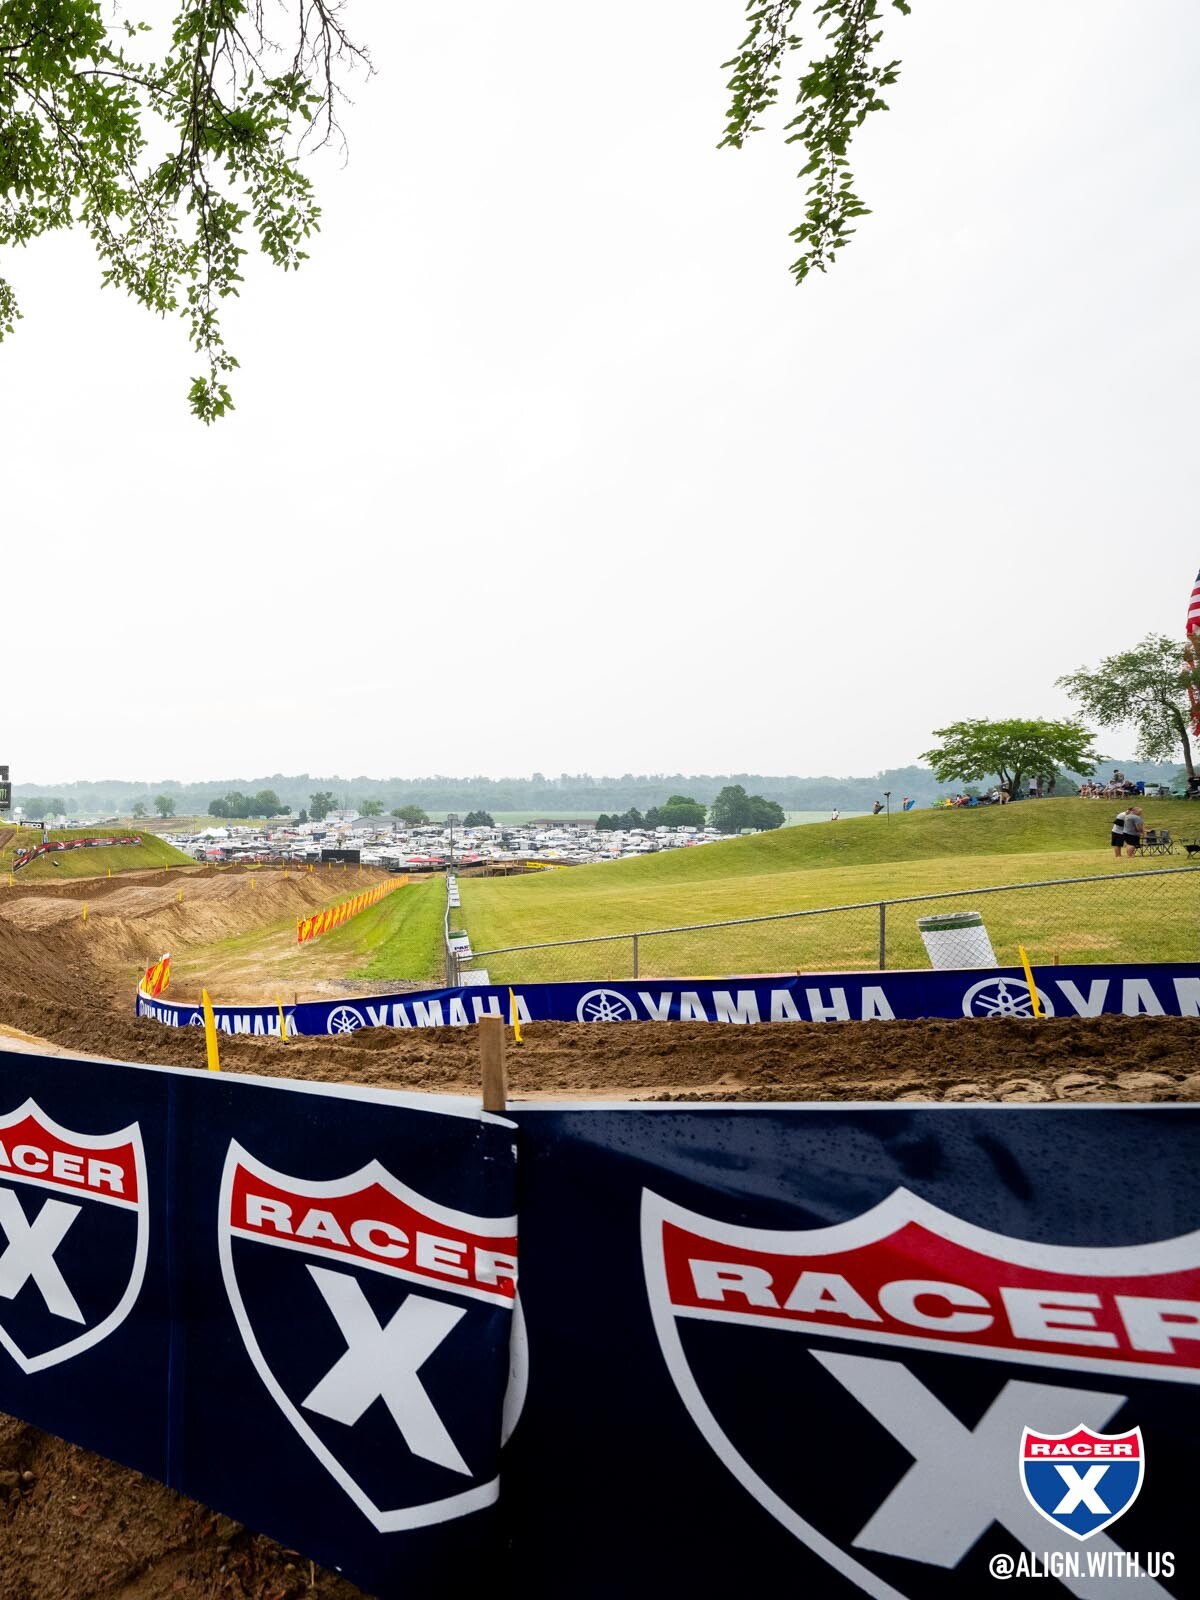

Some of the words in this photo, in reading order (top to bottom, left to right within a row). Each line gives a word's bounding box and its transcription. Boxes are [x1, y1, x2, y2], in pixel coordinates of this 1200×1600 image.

[637, 985, 897, 1024] YAMAHA
[300, 1263, 474, 1478] X
[807, 1348, 1179, 1600] X
